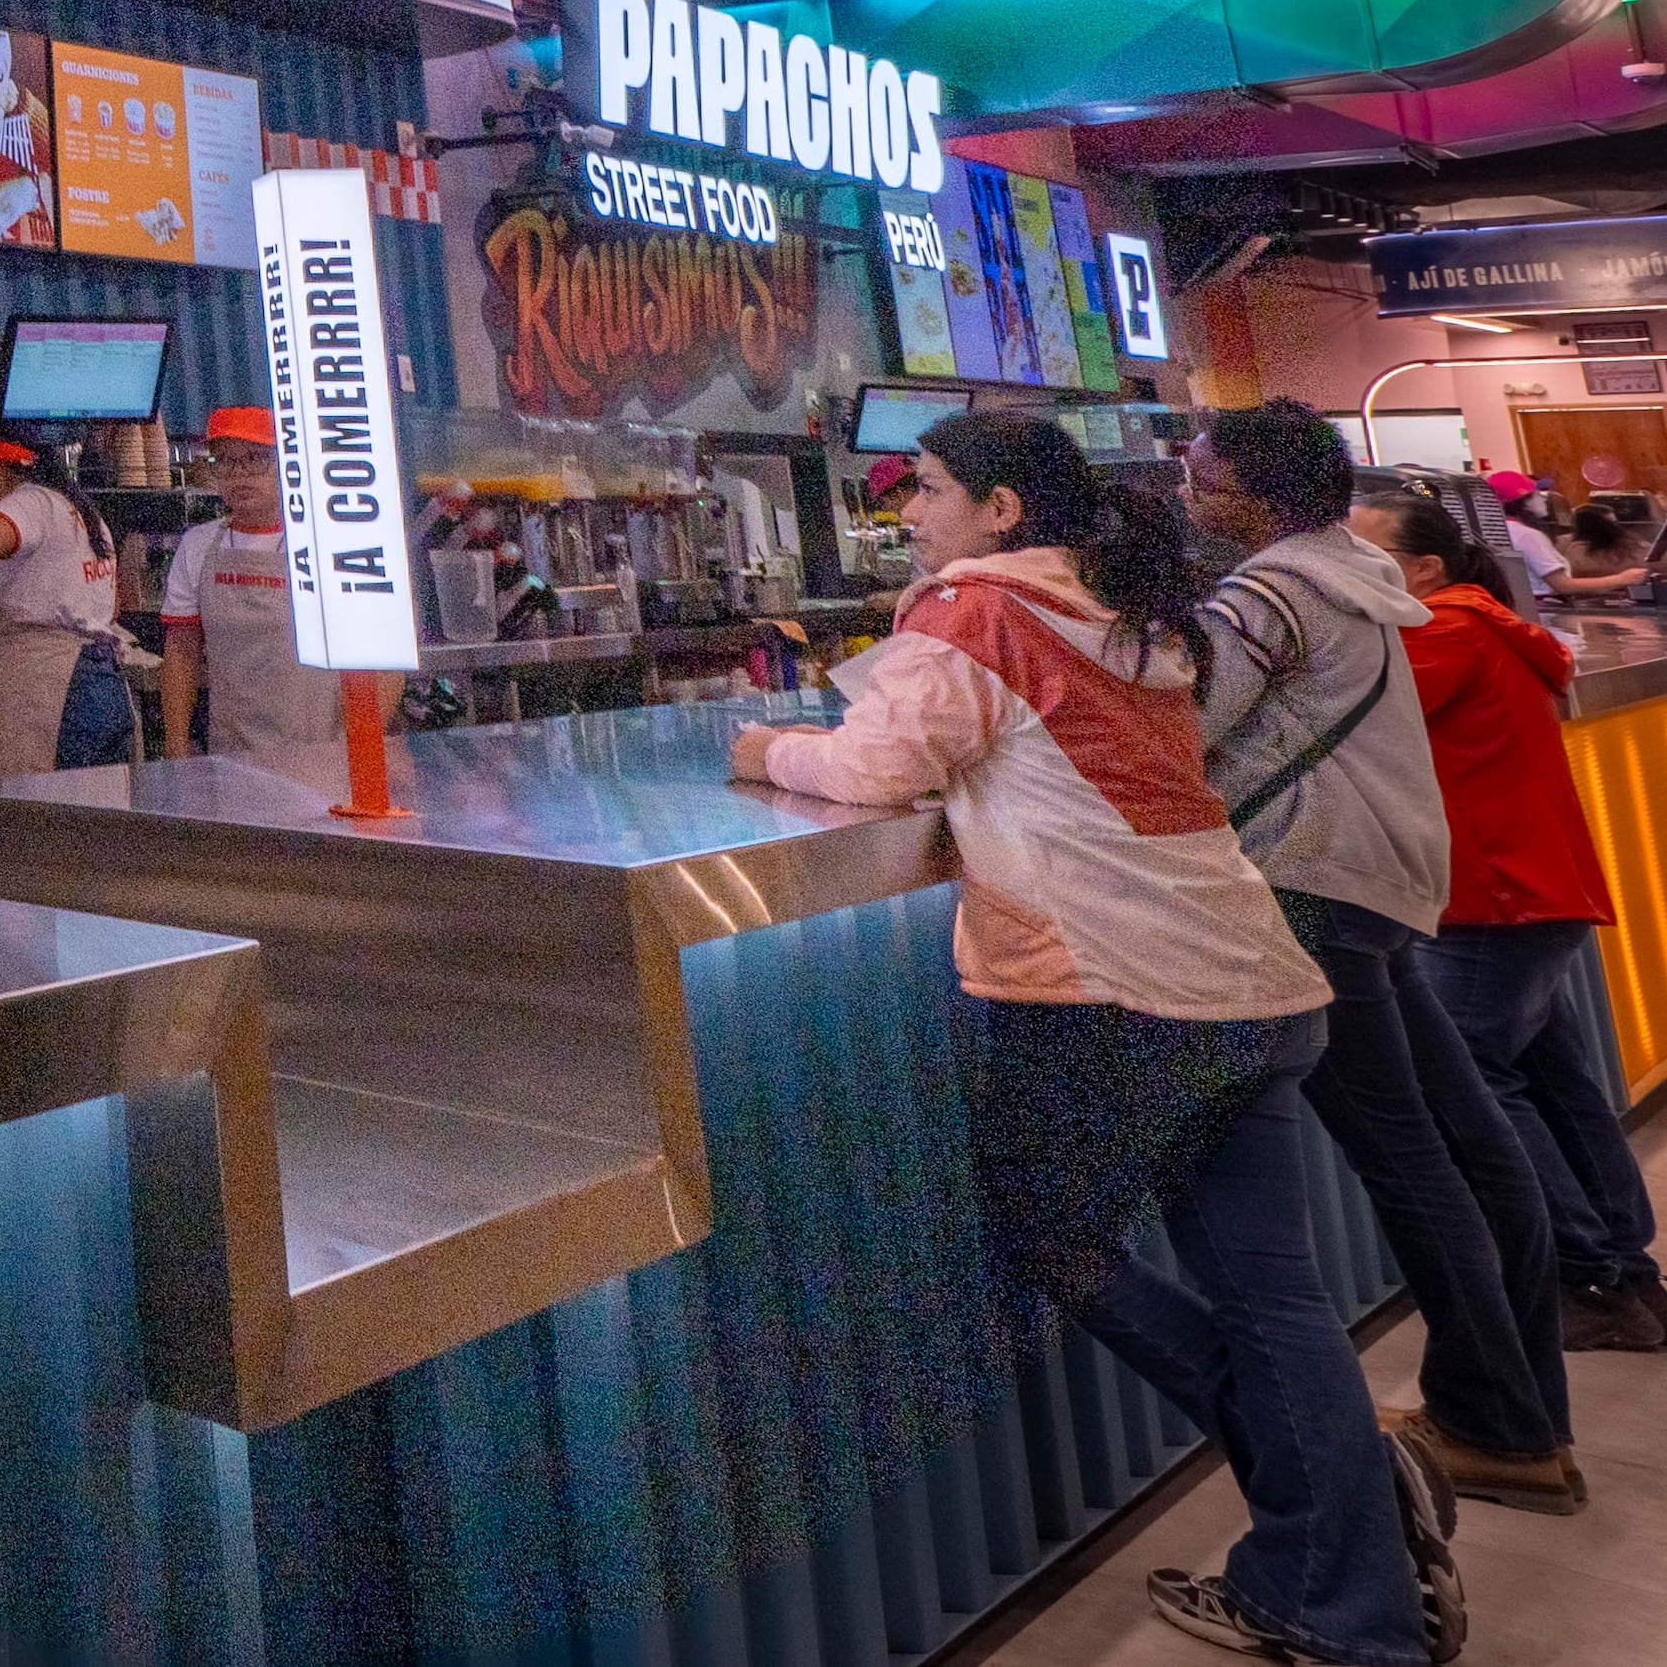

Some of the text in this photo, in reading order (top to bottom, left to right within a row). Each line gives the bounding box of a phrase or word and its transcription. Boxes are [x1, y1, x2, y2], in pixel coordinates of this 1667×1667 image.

[60, 60, 140, 86] GUARNICIONES
[68, 186, 110, 203] POSTRE
[585, 151, 778, 245] STREET FOOD
[883, 209, 947, 273] PERÚ
[1119, 251, 1152, 341] P
[1408, 265, 1438, 291] AJÍ
[1443, 268, 1470, 288] DE
[1474, 261, 1564, 287] GALLINA
[299, 238, 395, 595] ¡A COMERRRR!
